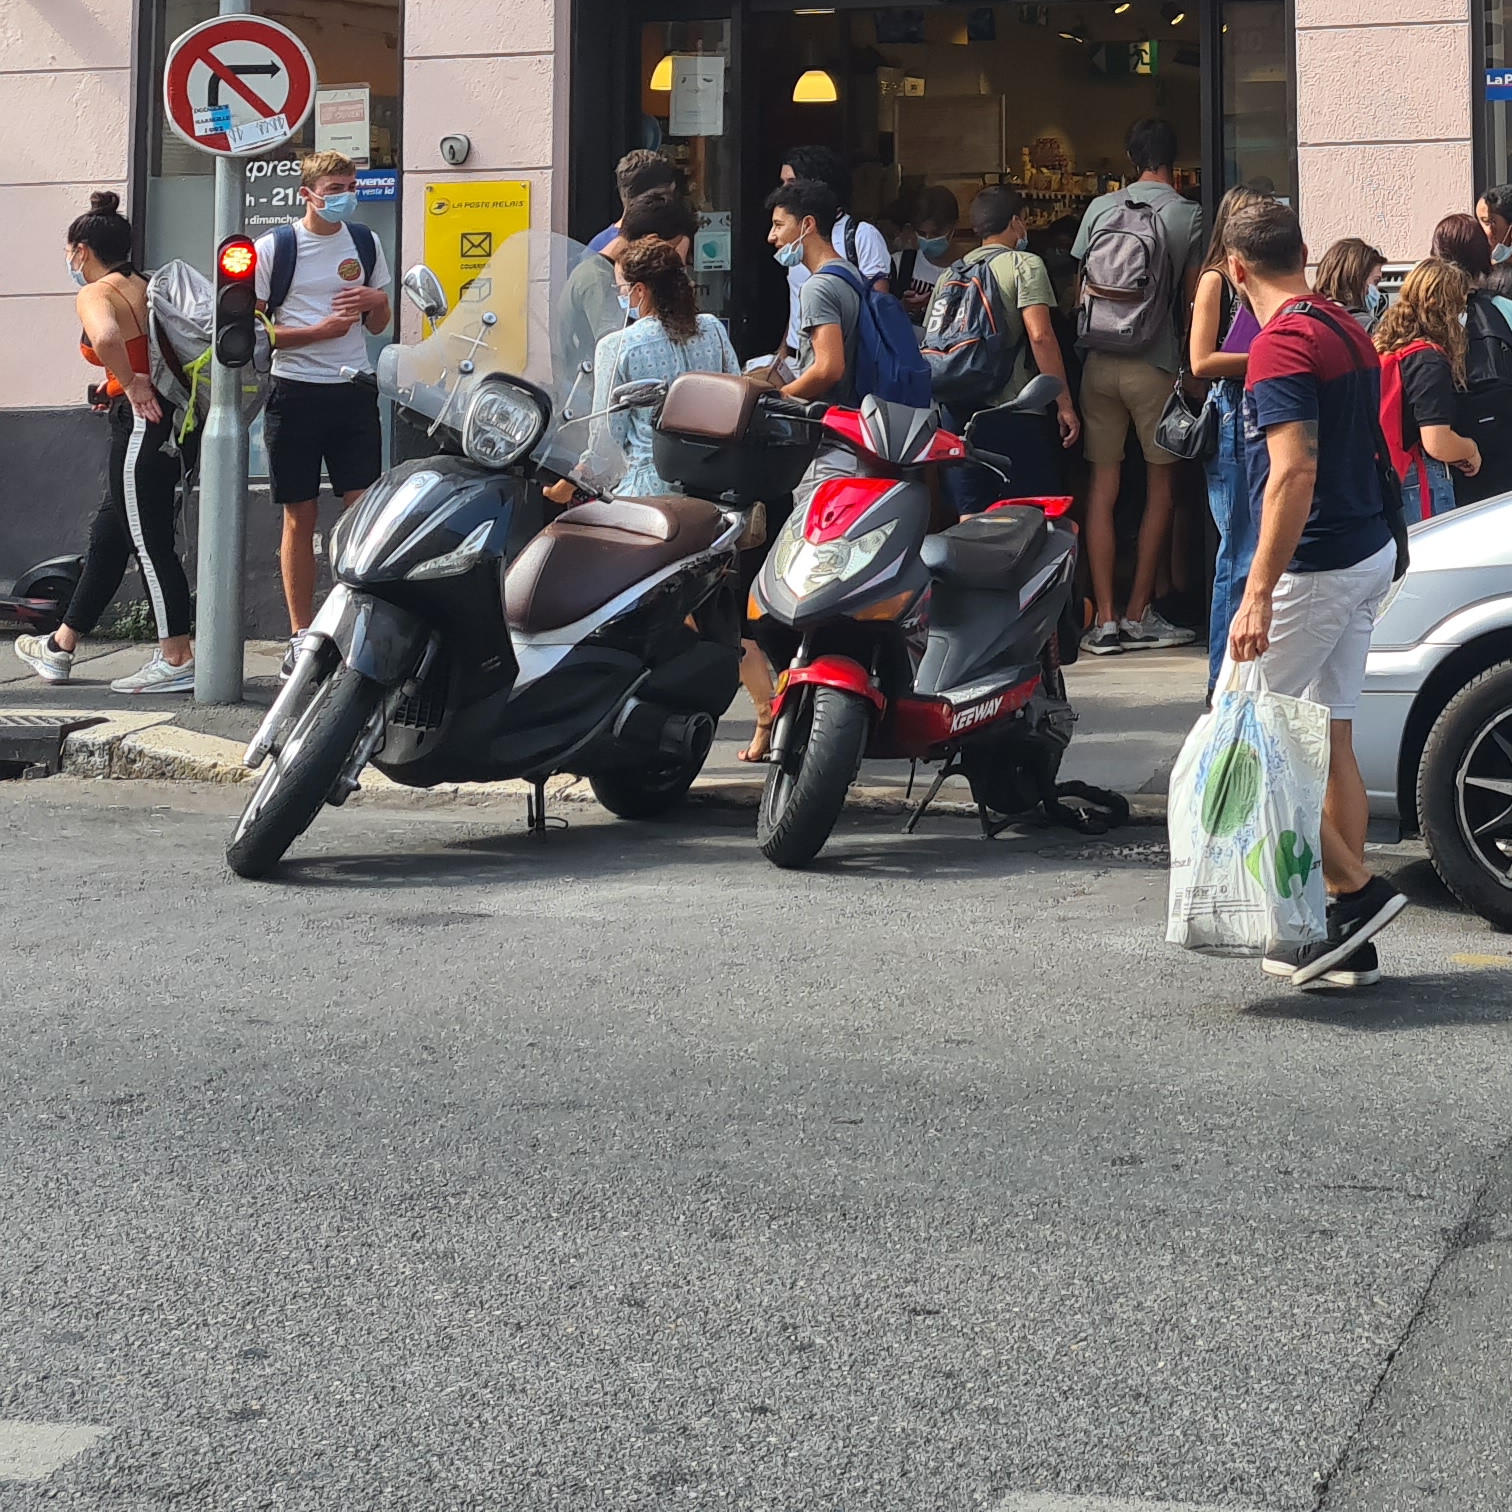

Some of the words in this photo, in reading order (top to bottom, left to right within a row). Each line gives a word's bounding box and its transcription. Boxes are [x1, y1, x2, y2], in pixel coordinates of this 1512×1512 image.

[1486, 74, 1502, 85] La
[464, 201, 490, 209] POSTE
[492, 200, 525, 208] RELAIS
[949, 695, 1004, 734] KEEWAY
